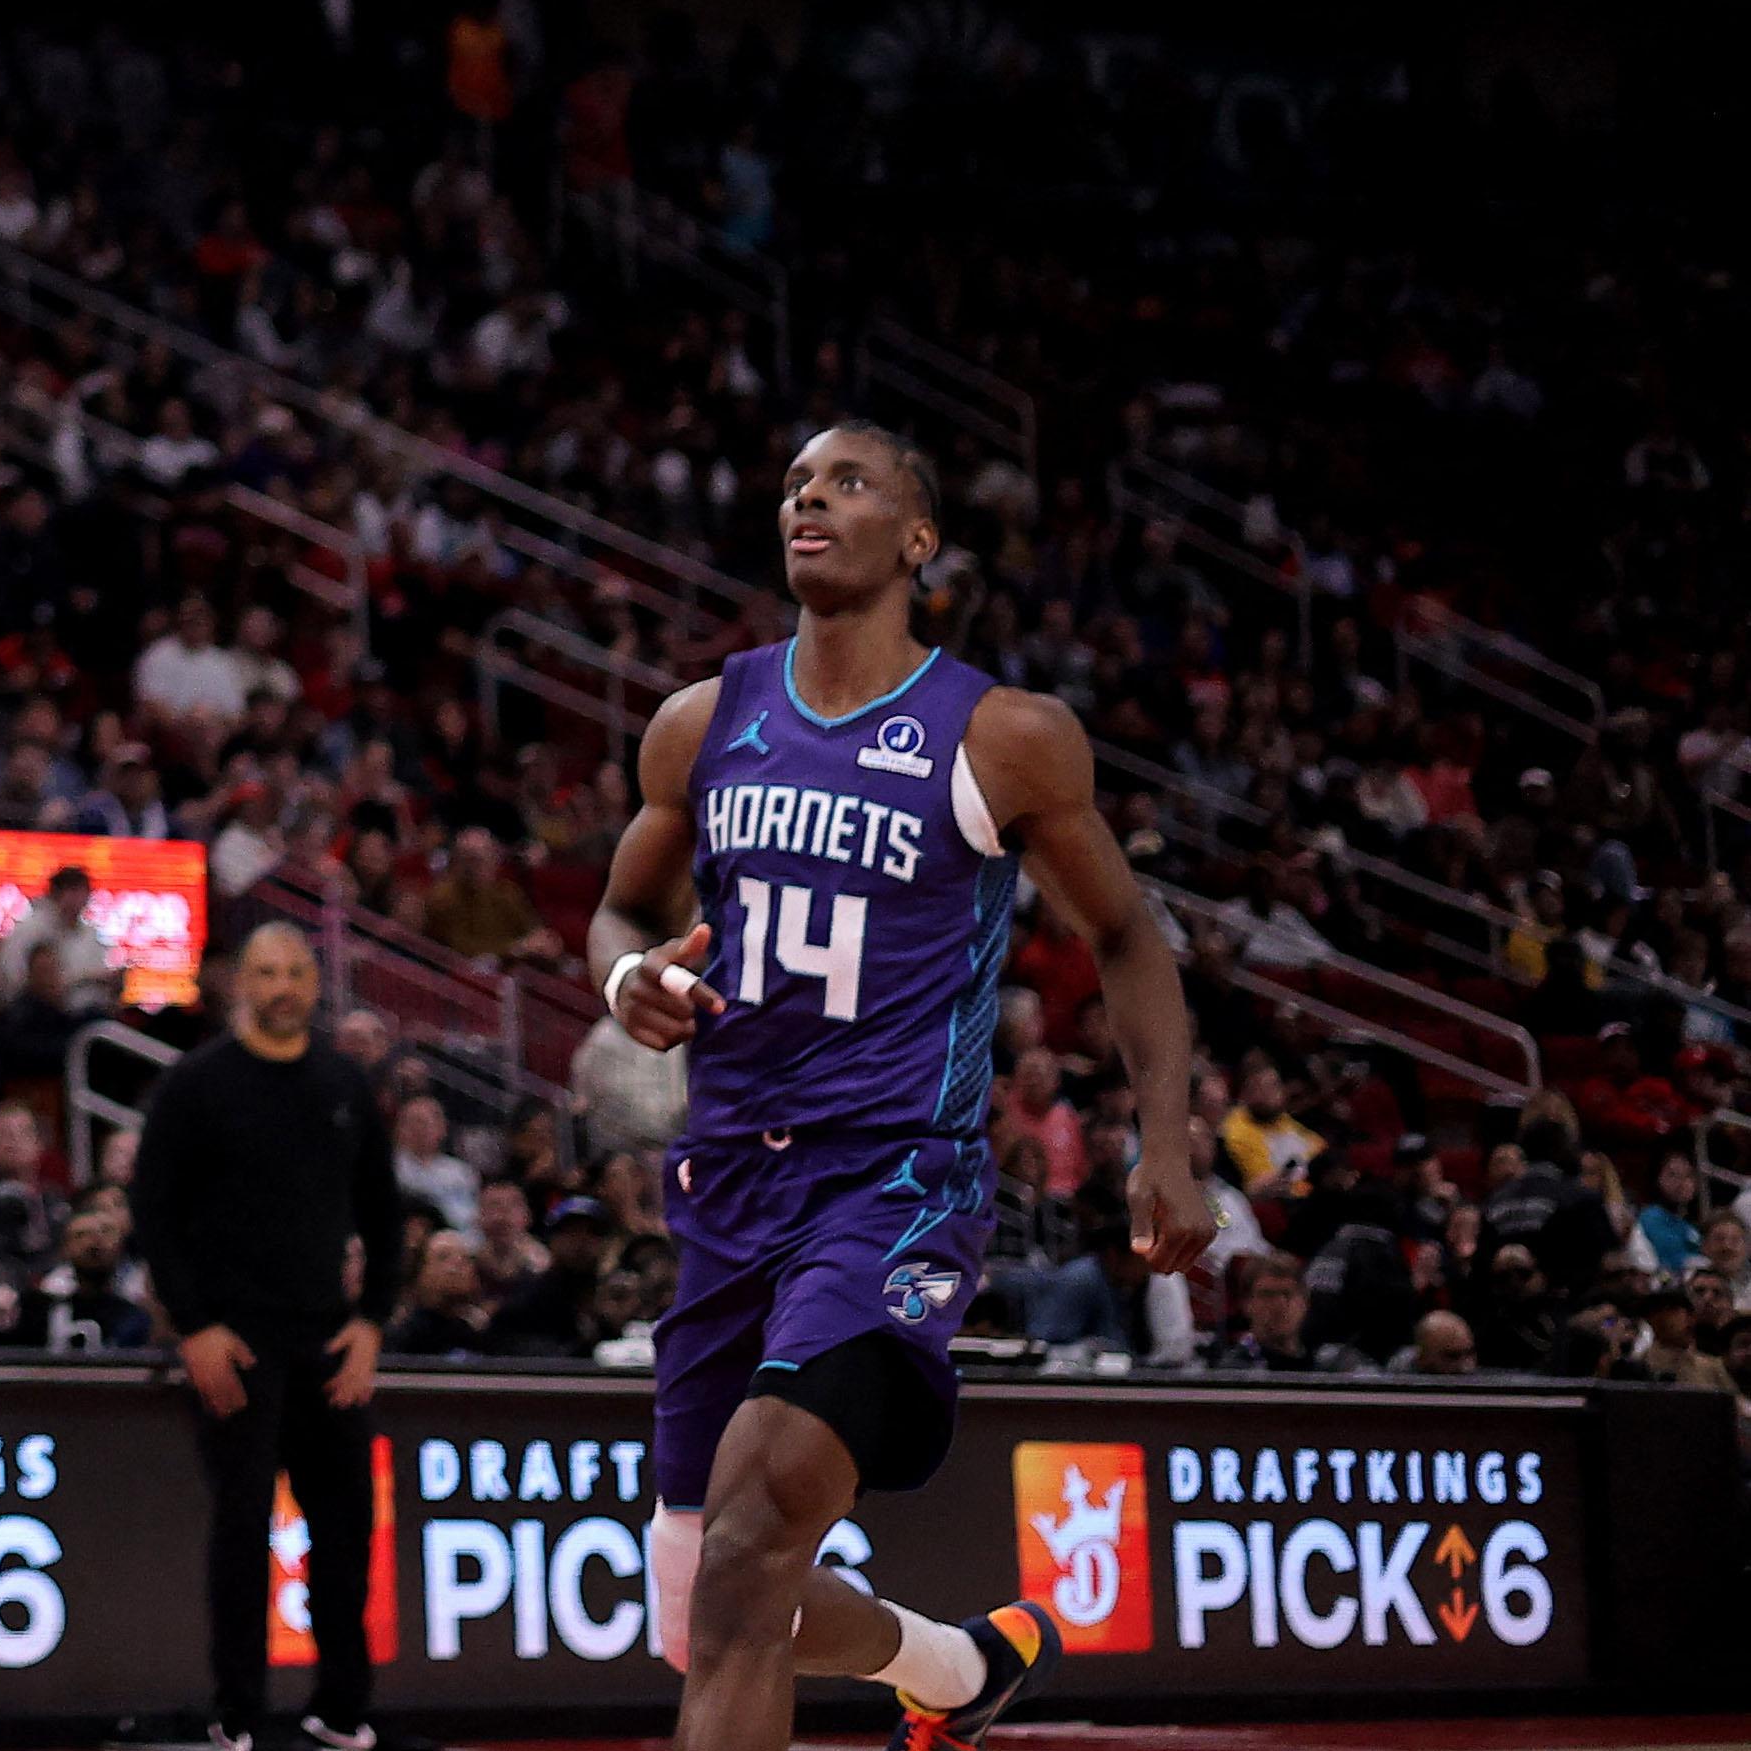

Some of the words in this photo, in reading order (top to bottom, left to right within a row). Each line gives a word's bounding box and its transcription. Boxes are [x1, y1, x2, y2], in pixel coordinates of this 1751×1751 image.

[705, 784, 924, 884] HORNETS
[737, 876, 869, 1023] 14
[418, 1438, 648, 1503] DRAFT
[1167, 1445, 1544, 1505] DRAFTKINGS
[421, 1516, 663, 1661] PIC
[1172, 1519, 1438, 1650] PICK
[1480, 1519, 1554, 1648] 6
